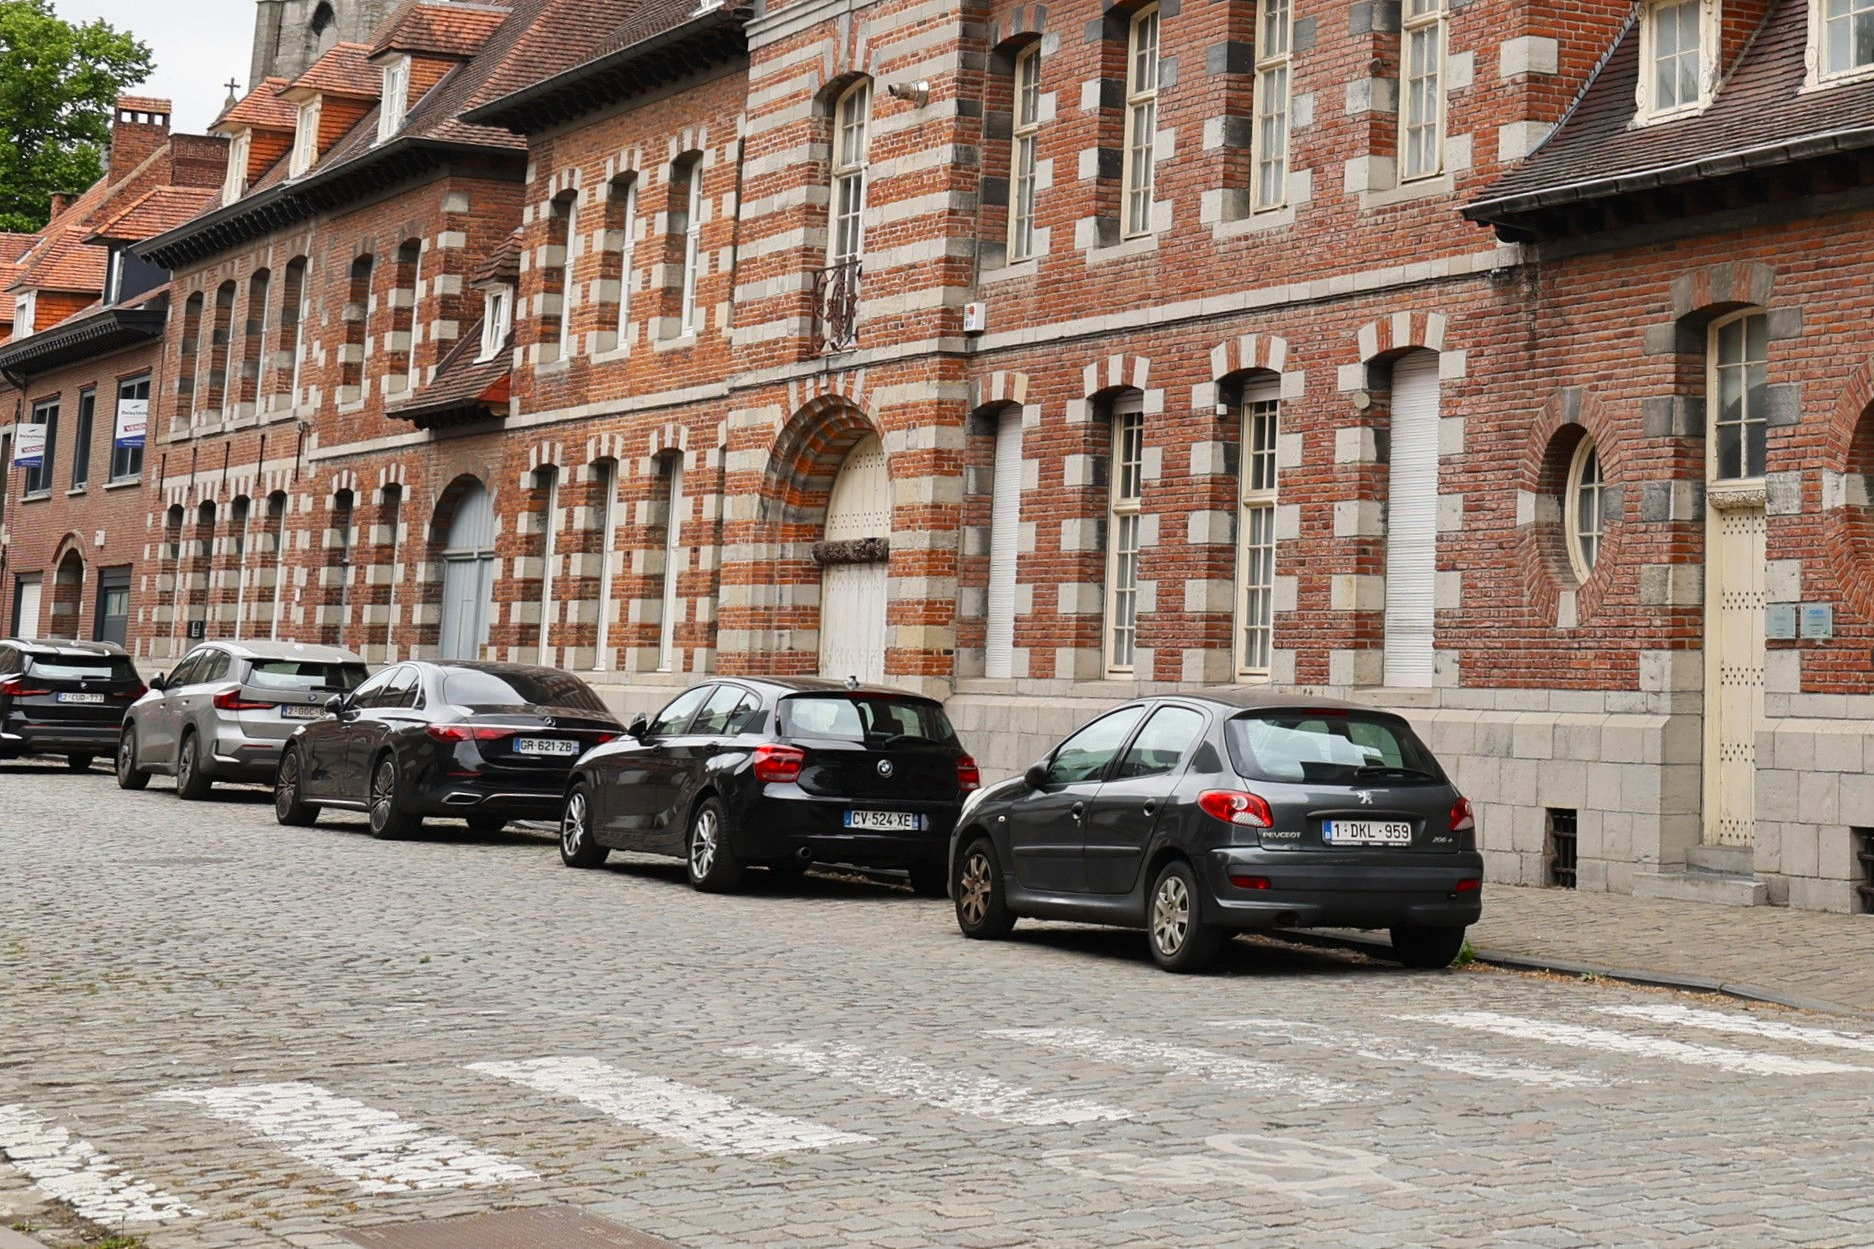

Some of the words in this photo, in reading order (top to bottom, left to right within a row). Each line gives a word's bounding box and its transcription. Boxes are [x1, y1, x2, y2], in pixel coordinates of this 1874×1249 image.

[520, 739, 573, 752] GR-621-ZB
[852, 811, 911, 827] CV-524-XE
[1262, 831, 1302, 839] PEUGEOT
